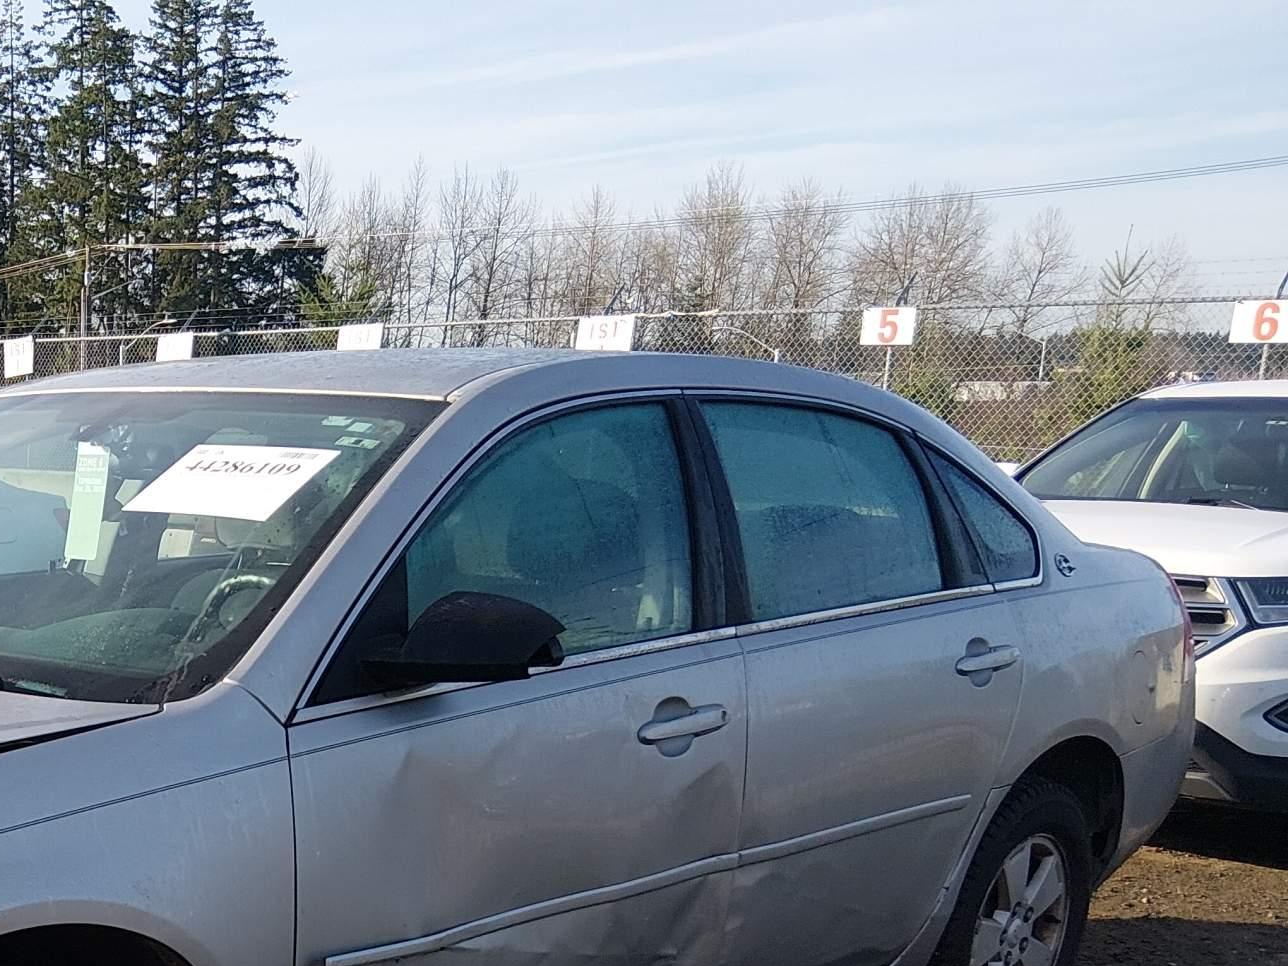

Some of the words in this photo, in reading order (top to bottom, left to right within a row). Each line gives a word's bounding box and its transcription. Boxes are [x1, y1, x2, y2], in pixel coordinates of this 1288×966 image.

[878, 308, 900, 344] 5
[1252, 302, 1281, 341] 6
[185, 459, 302, 476] 44286109
